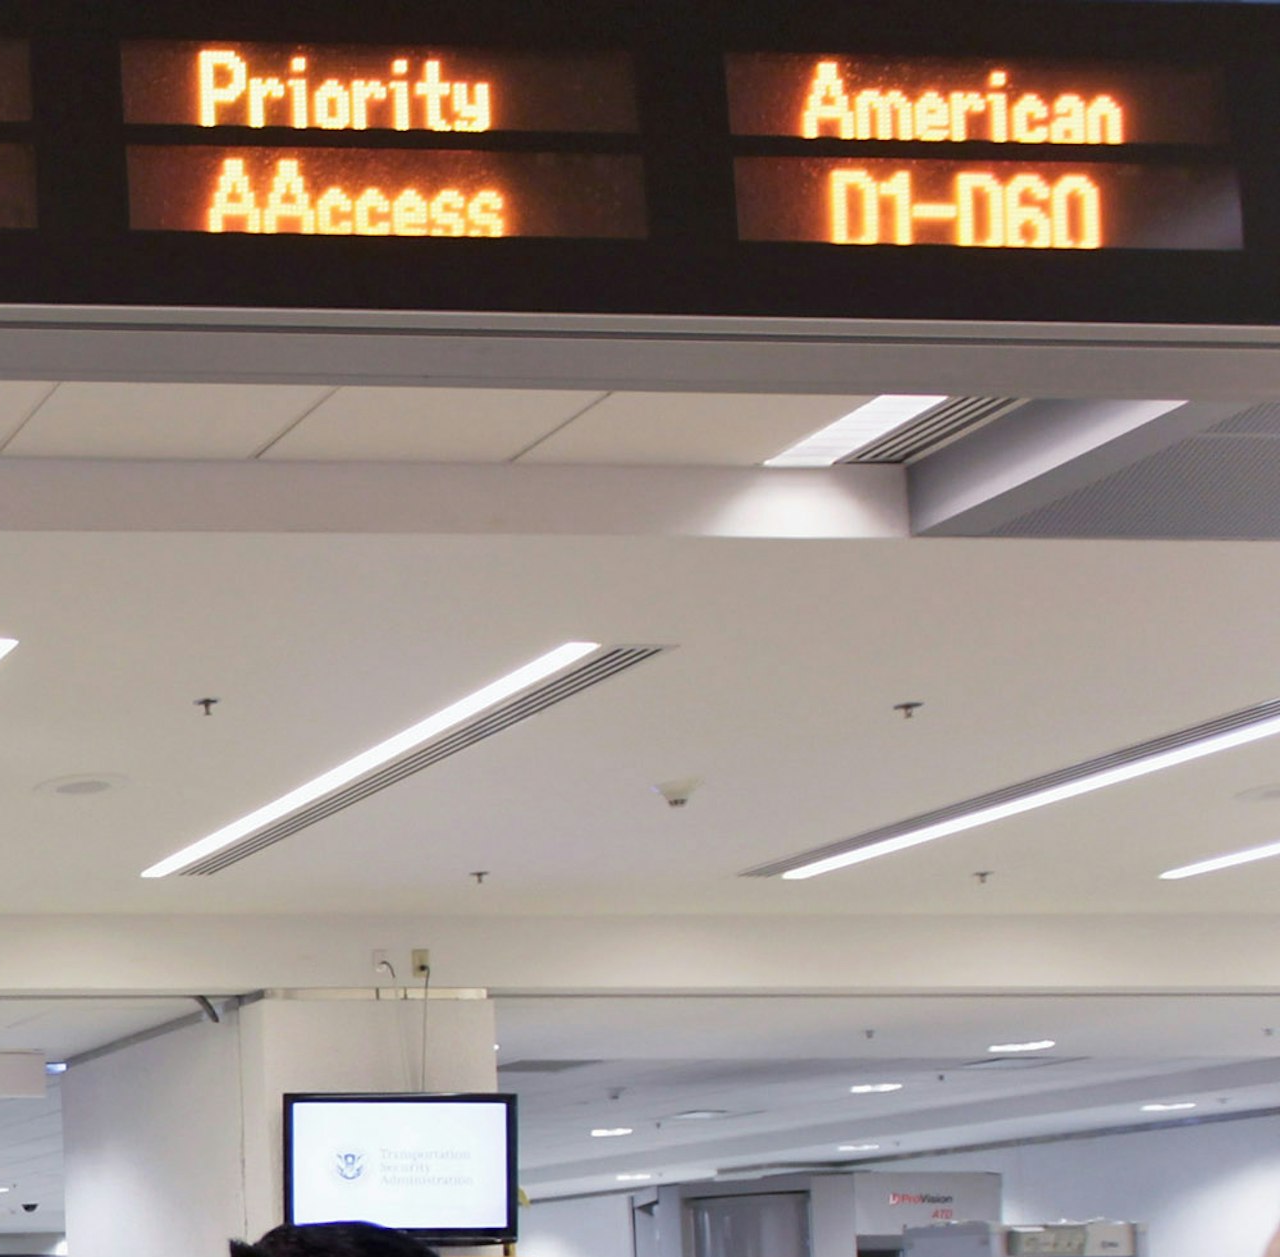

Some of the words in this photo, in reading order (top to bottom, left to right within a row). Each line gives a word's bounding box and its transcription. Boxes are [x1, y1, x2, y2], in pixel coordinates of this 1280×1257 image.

[192, 47, 495, 132] Priority
[794, 59, 1126, 145] American
[199, 153, 513, 239] AAccess
[820, 161, 1104, 250] D1-D60
